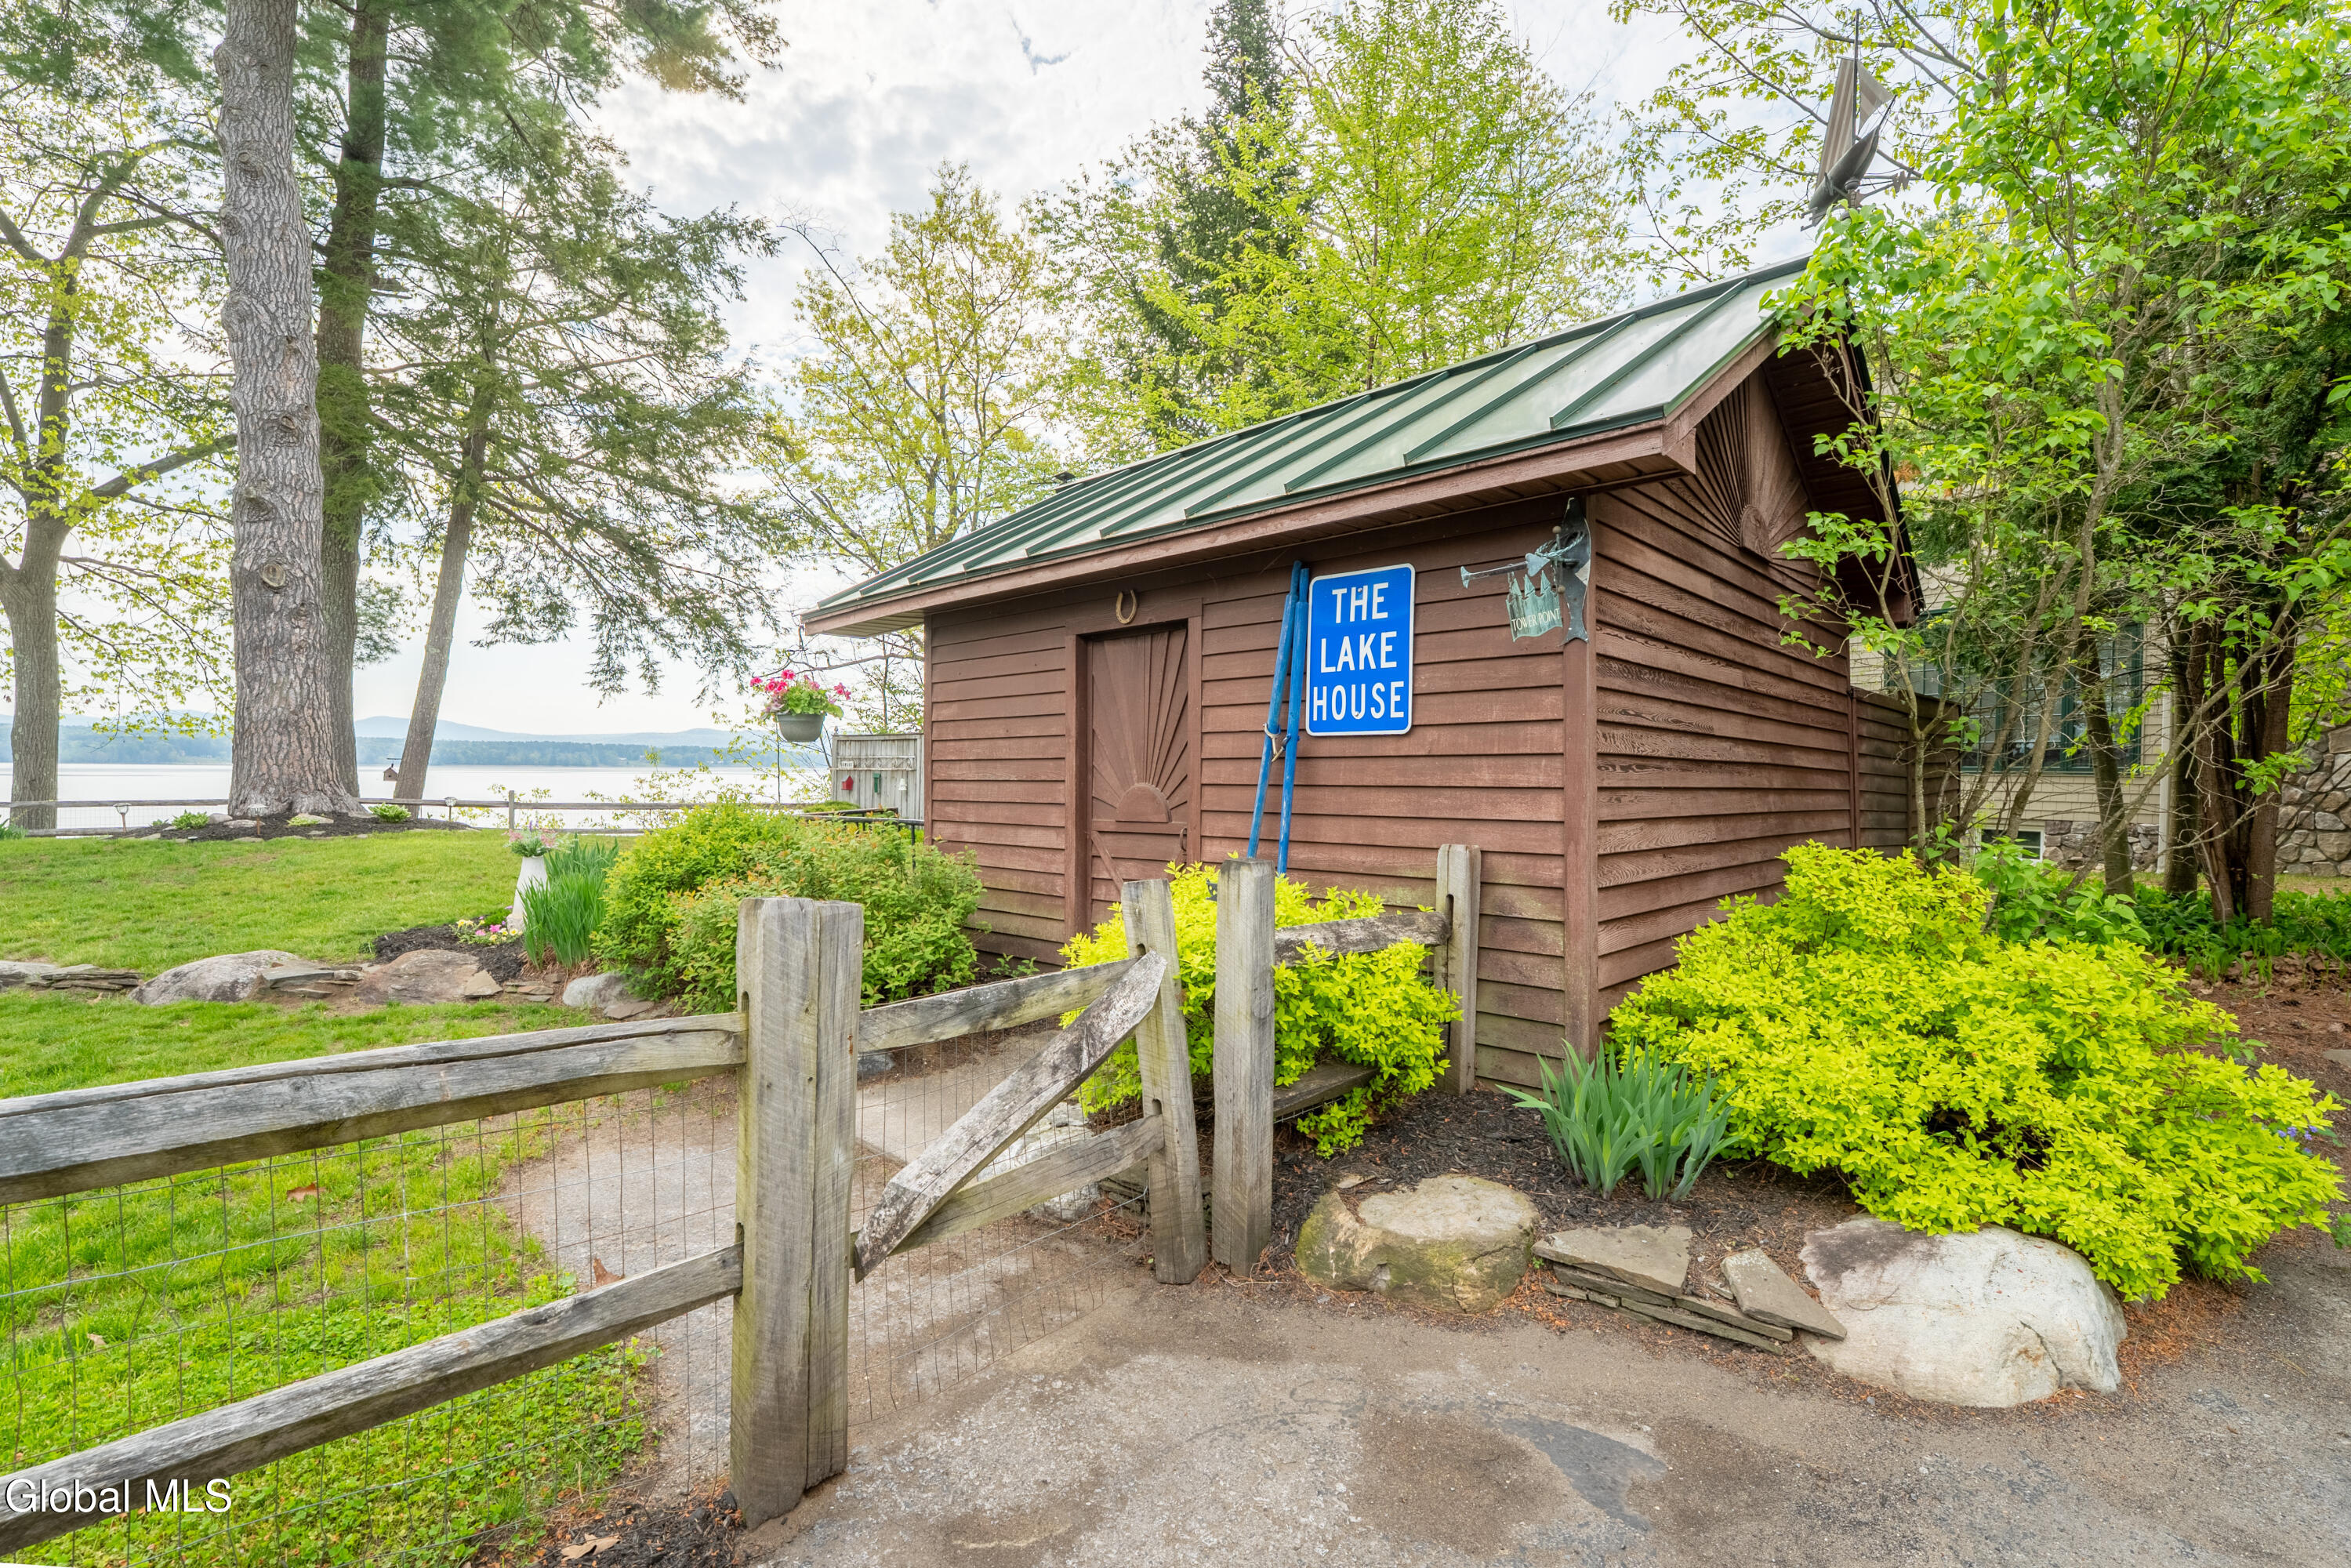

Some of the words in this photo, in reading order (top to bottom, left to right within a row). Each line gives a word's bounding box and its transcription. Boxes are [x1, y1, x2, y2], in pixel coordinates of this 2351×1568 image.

[1332, 582, 1389, 624] THE
[1511, 615, 1537, 631] TOWER
[1539, 608, 1560, 625] POINT
[1320, 630, 1397, 673] LAKE
[1312, 681, 1404, 721] HOUSE
